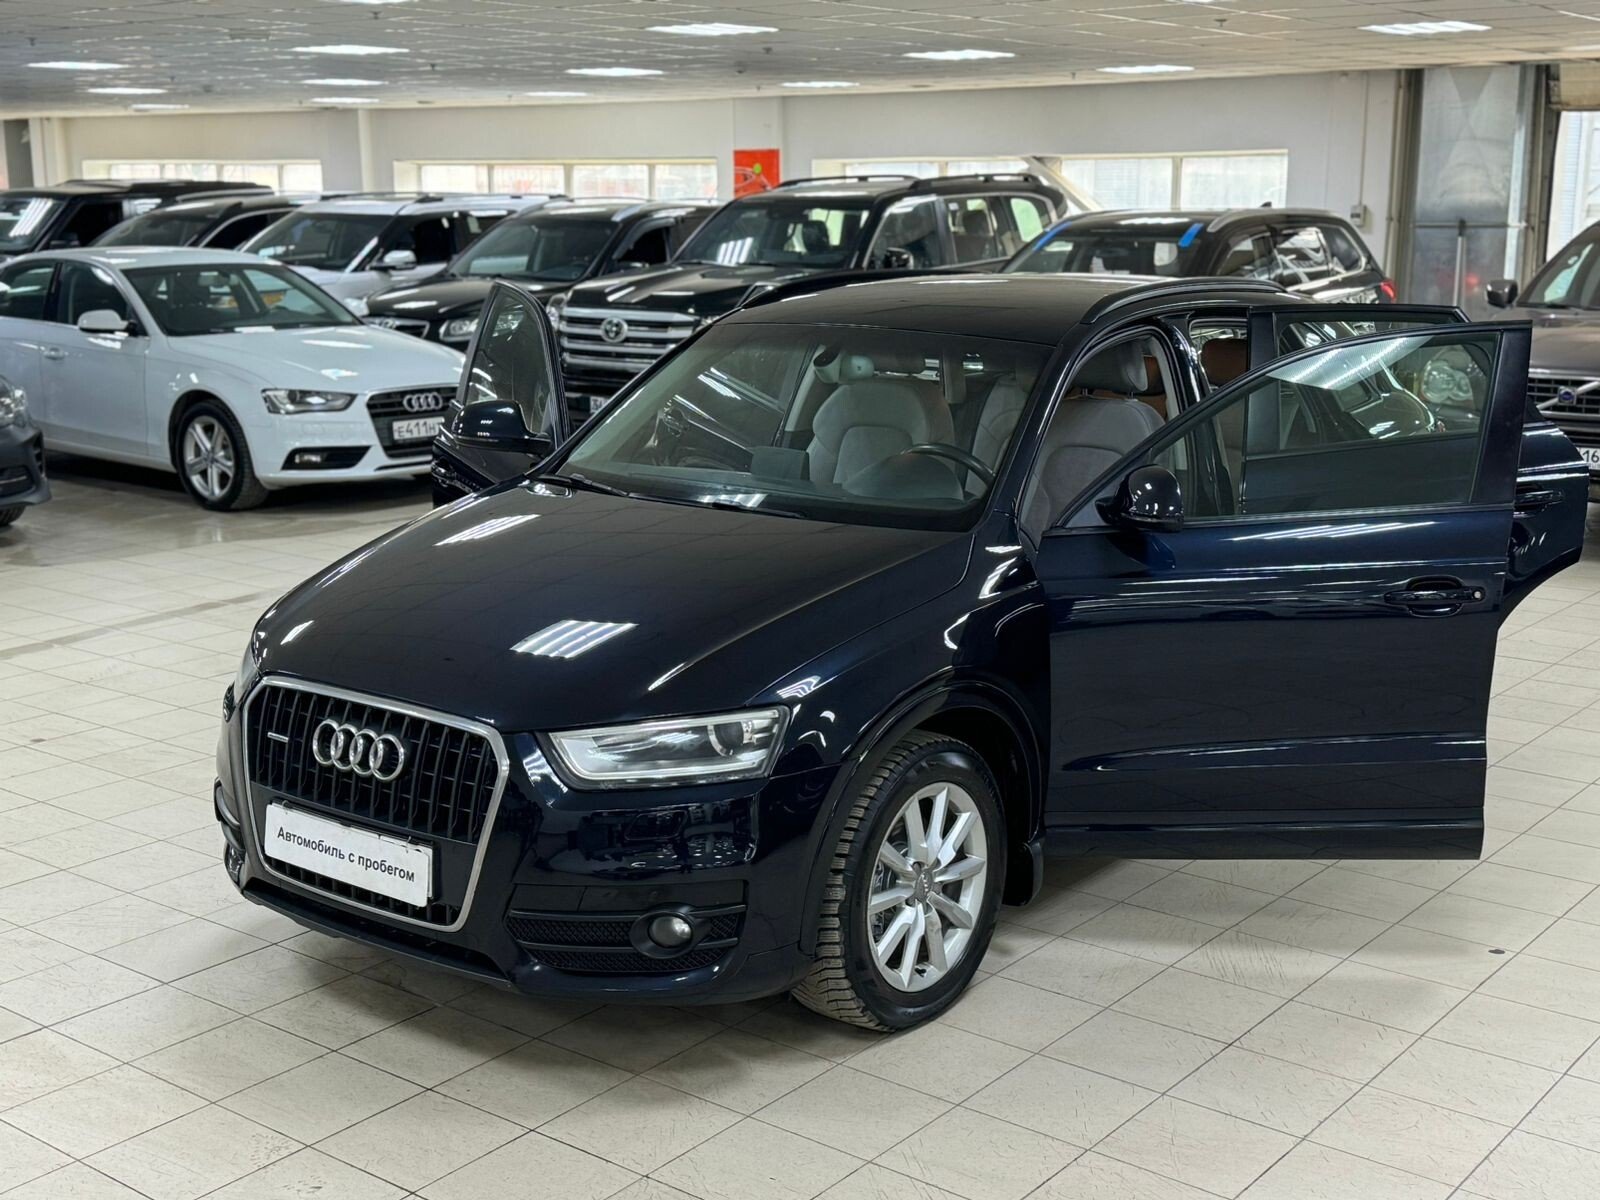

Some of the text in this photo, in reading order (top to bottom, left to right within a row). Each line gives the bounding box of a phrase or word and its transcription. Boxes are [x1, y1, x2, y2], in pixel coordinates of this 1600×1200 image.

[397, 421, 442, 438] E411H
[277, 826, 415, 882] Автомобиль с пробегом
